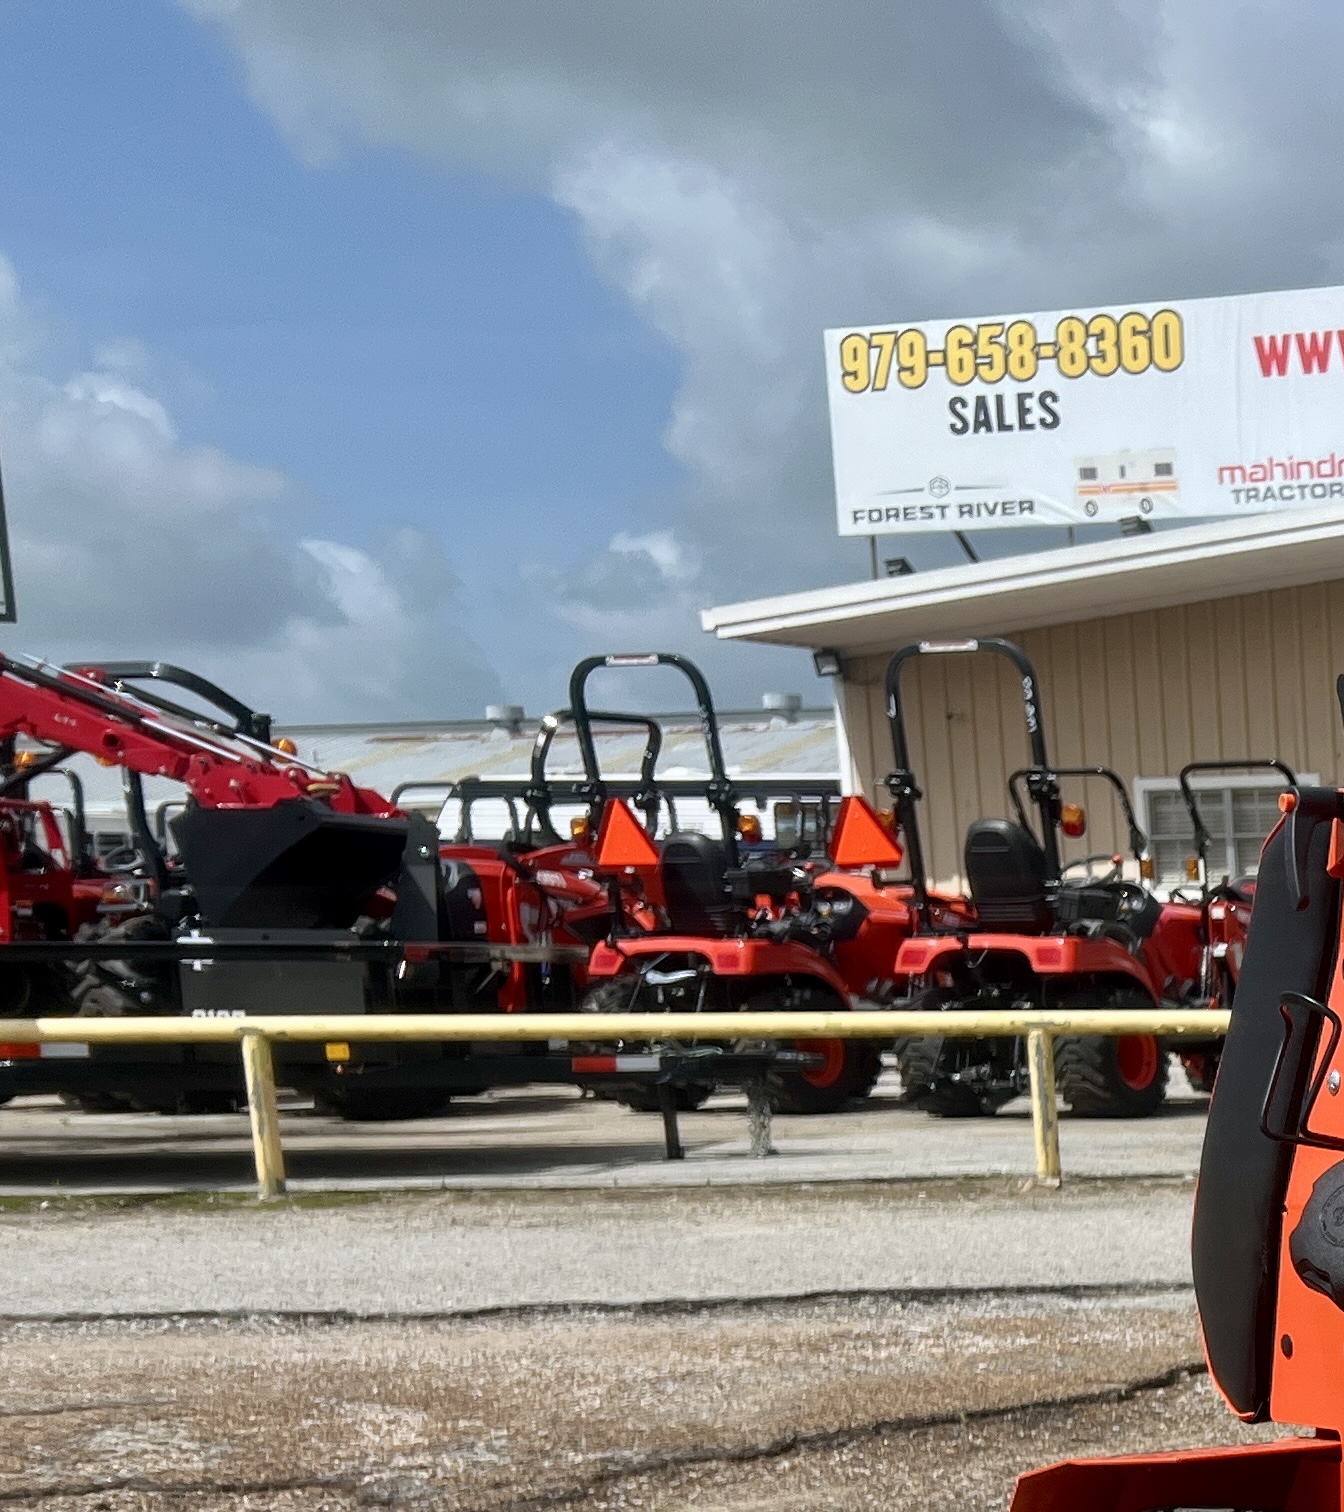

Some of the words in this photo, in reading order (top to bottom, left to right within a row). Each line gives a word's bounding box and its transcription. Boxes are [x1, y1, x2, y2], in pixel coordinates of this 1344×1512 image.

[840, 309, 1184, 394] 979-658-8360
[949, 390, 1061, 436] SALES
[852, 503, 950, 525] FOREST
[959, 499, 1035, 518] RIVER
